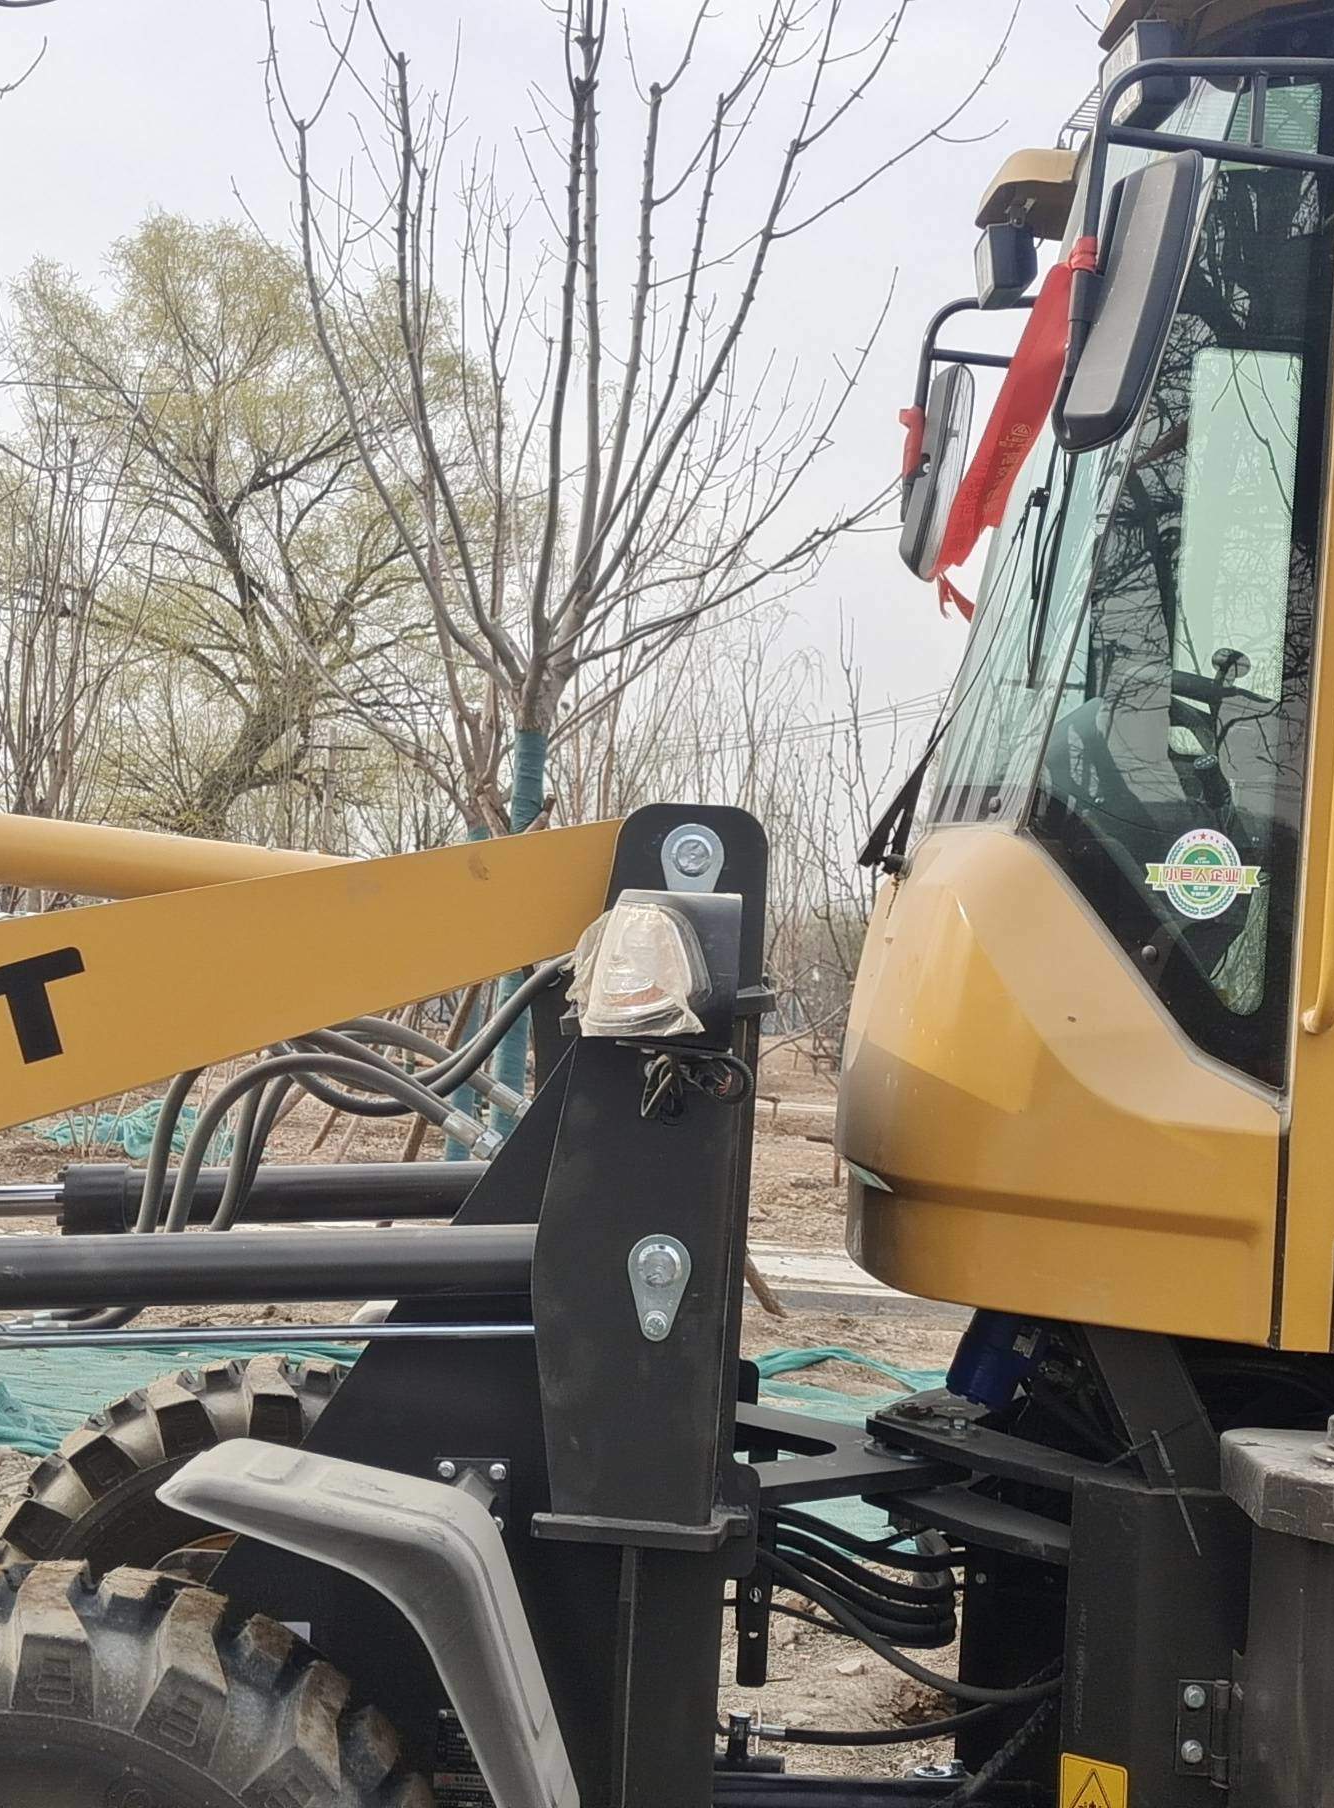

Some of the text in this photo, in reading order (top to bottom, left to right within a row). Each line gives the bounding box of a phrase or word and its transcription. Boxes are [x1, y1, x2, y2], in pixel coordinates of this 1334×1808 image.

[1165, 868, 1238, 883] 小巨人企业
